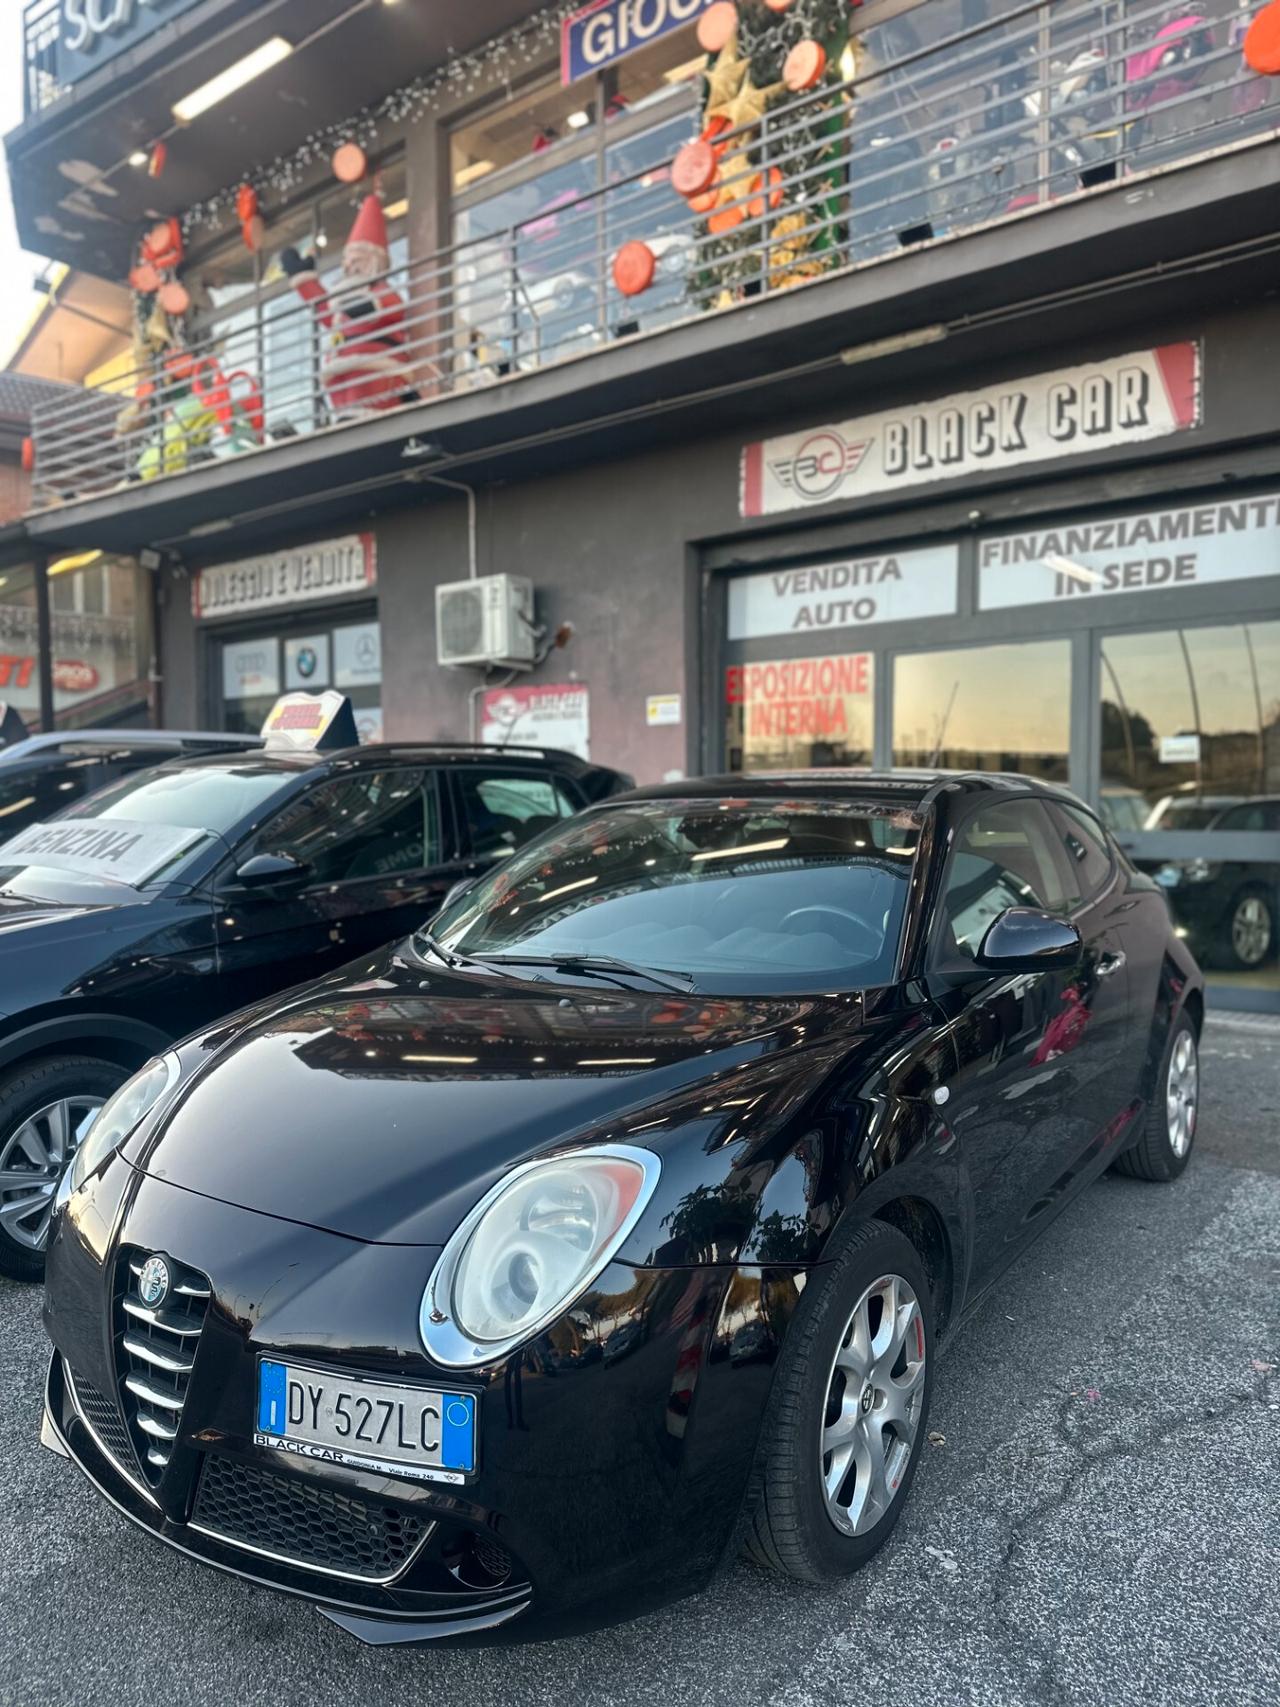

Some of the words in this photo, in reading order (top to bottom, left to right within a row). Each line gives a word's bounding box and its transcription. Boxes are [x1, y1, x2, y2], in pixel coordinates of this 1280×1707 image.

[882, 391, 1027, 476] BLACK
[1047, 366, 1149, 442] CAR
[773, 558, 902, 597] VENDITA
[1102, 553, 1197, 591] SEDE
[792, 598, 877, 629] AUTO
[726, 656, 869, 705] ESPOSIZIONE
[750, 697, 849, 737] INTERNA
[287, 1380, 324, 1431] DY
[334, 1392, 440, 1453] 527LC
[255, 1434, 307, 1455] BLACK
[309, 1446, 344, 1463] CAR
